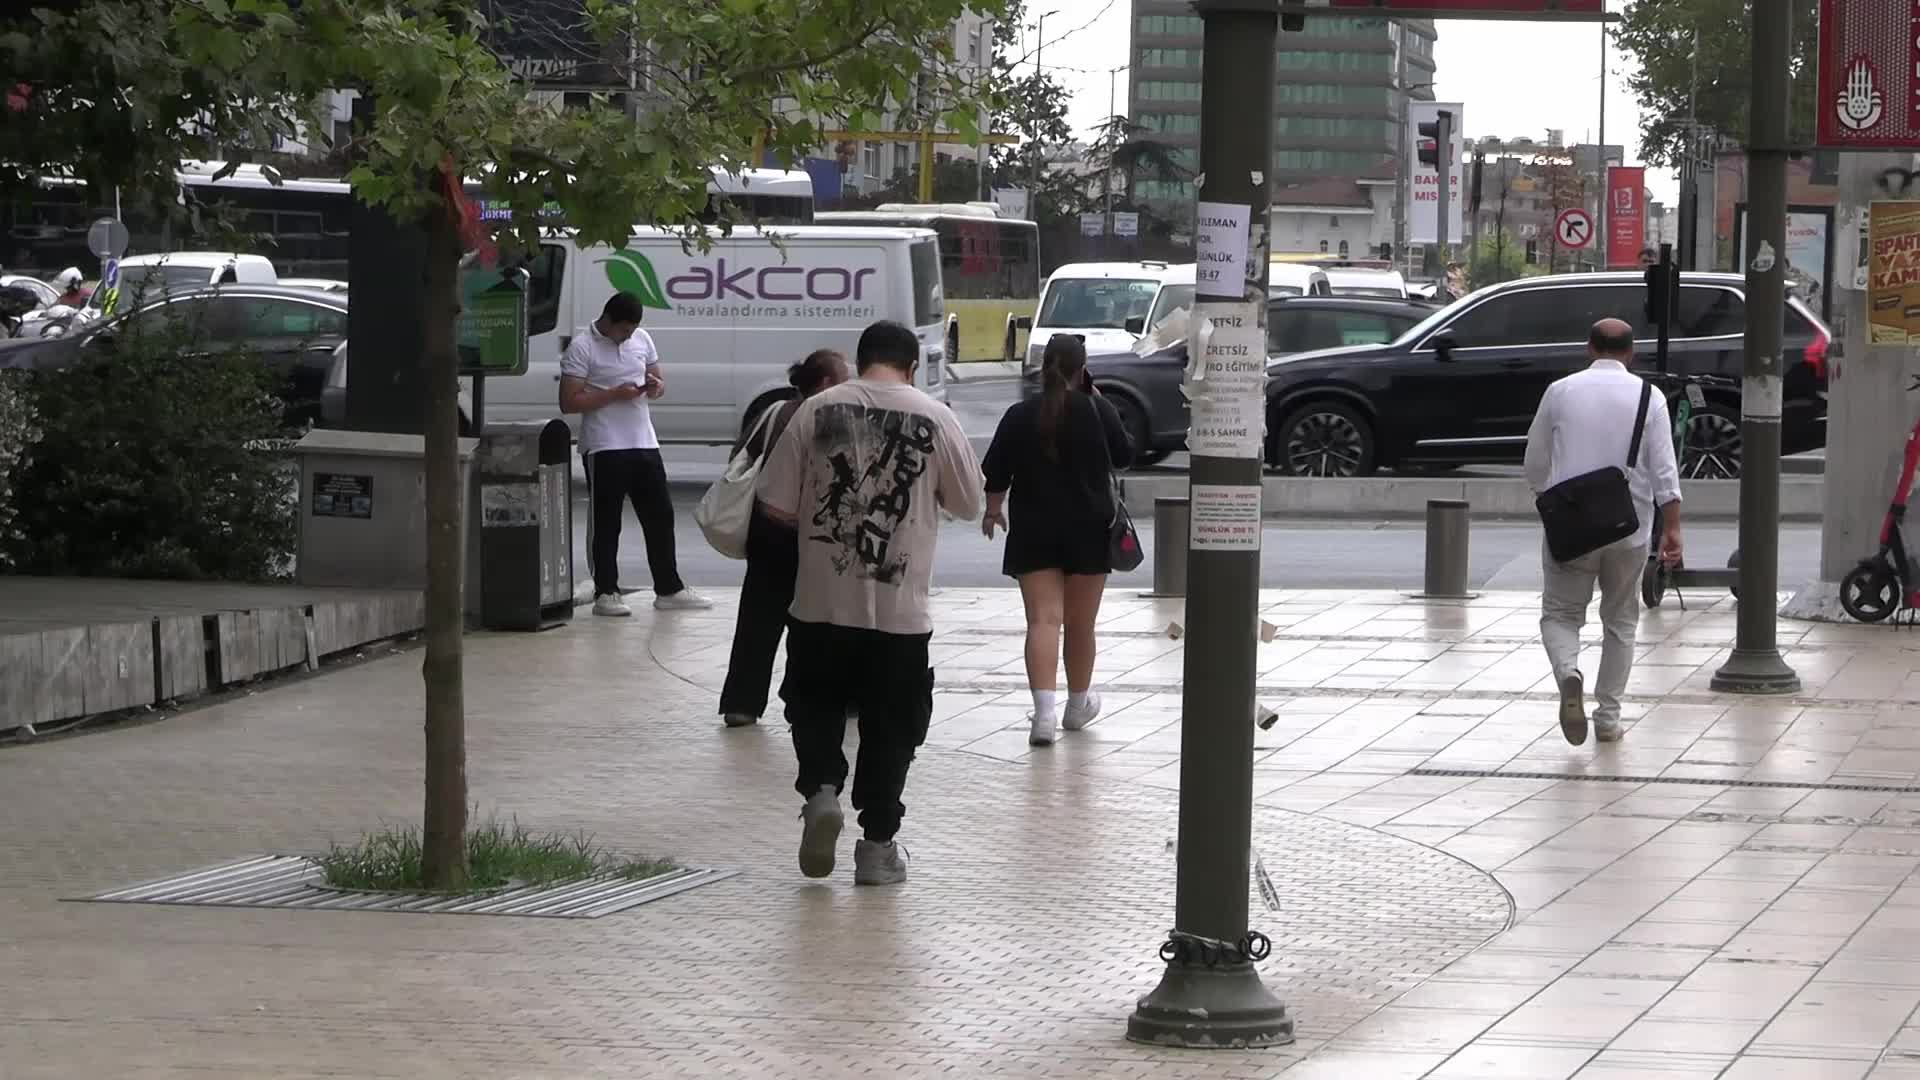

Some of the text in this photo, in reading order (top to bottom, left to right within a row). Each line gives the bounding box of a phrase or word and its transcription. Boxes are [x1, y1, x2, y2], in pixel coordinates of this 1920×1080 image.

[1414, 175, 1458, 185] BAKR
[665, 258, 876, 301] akcor
[677, 303, 875, 318] havalandırma sistemleri
[1217, 428, 1247, 438] SAHNE
